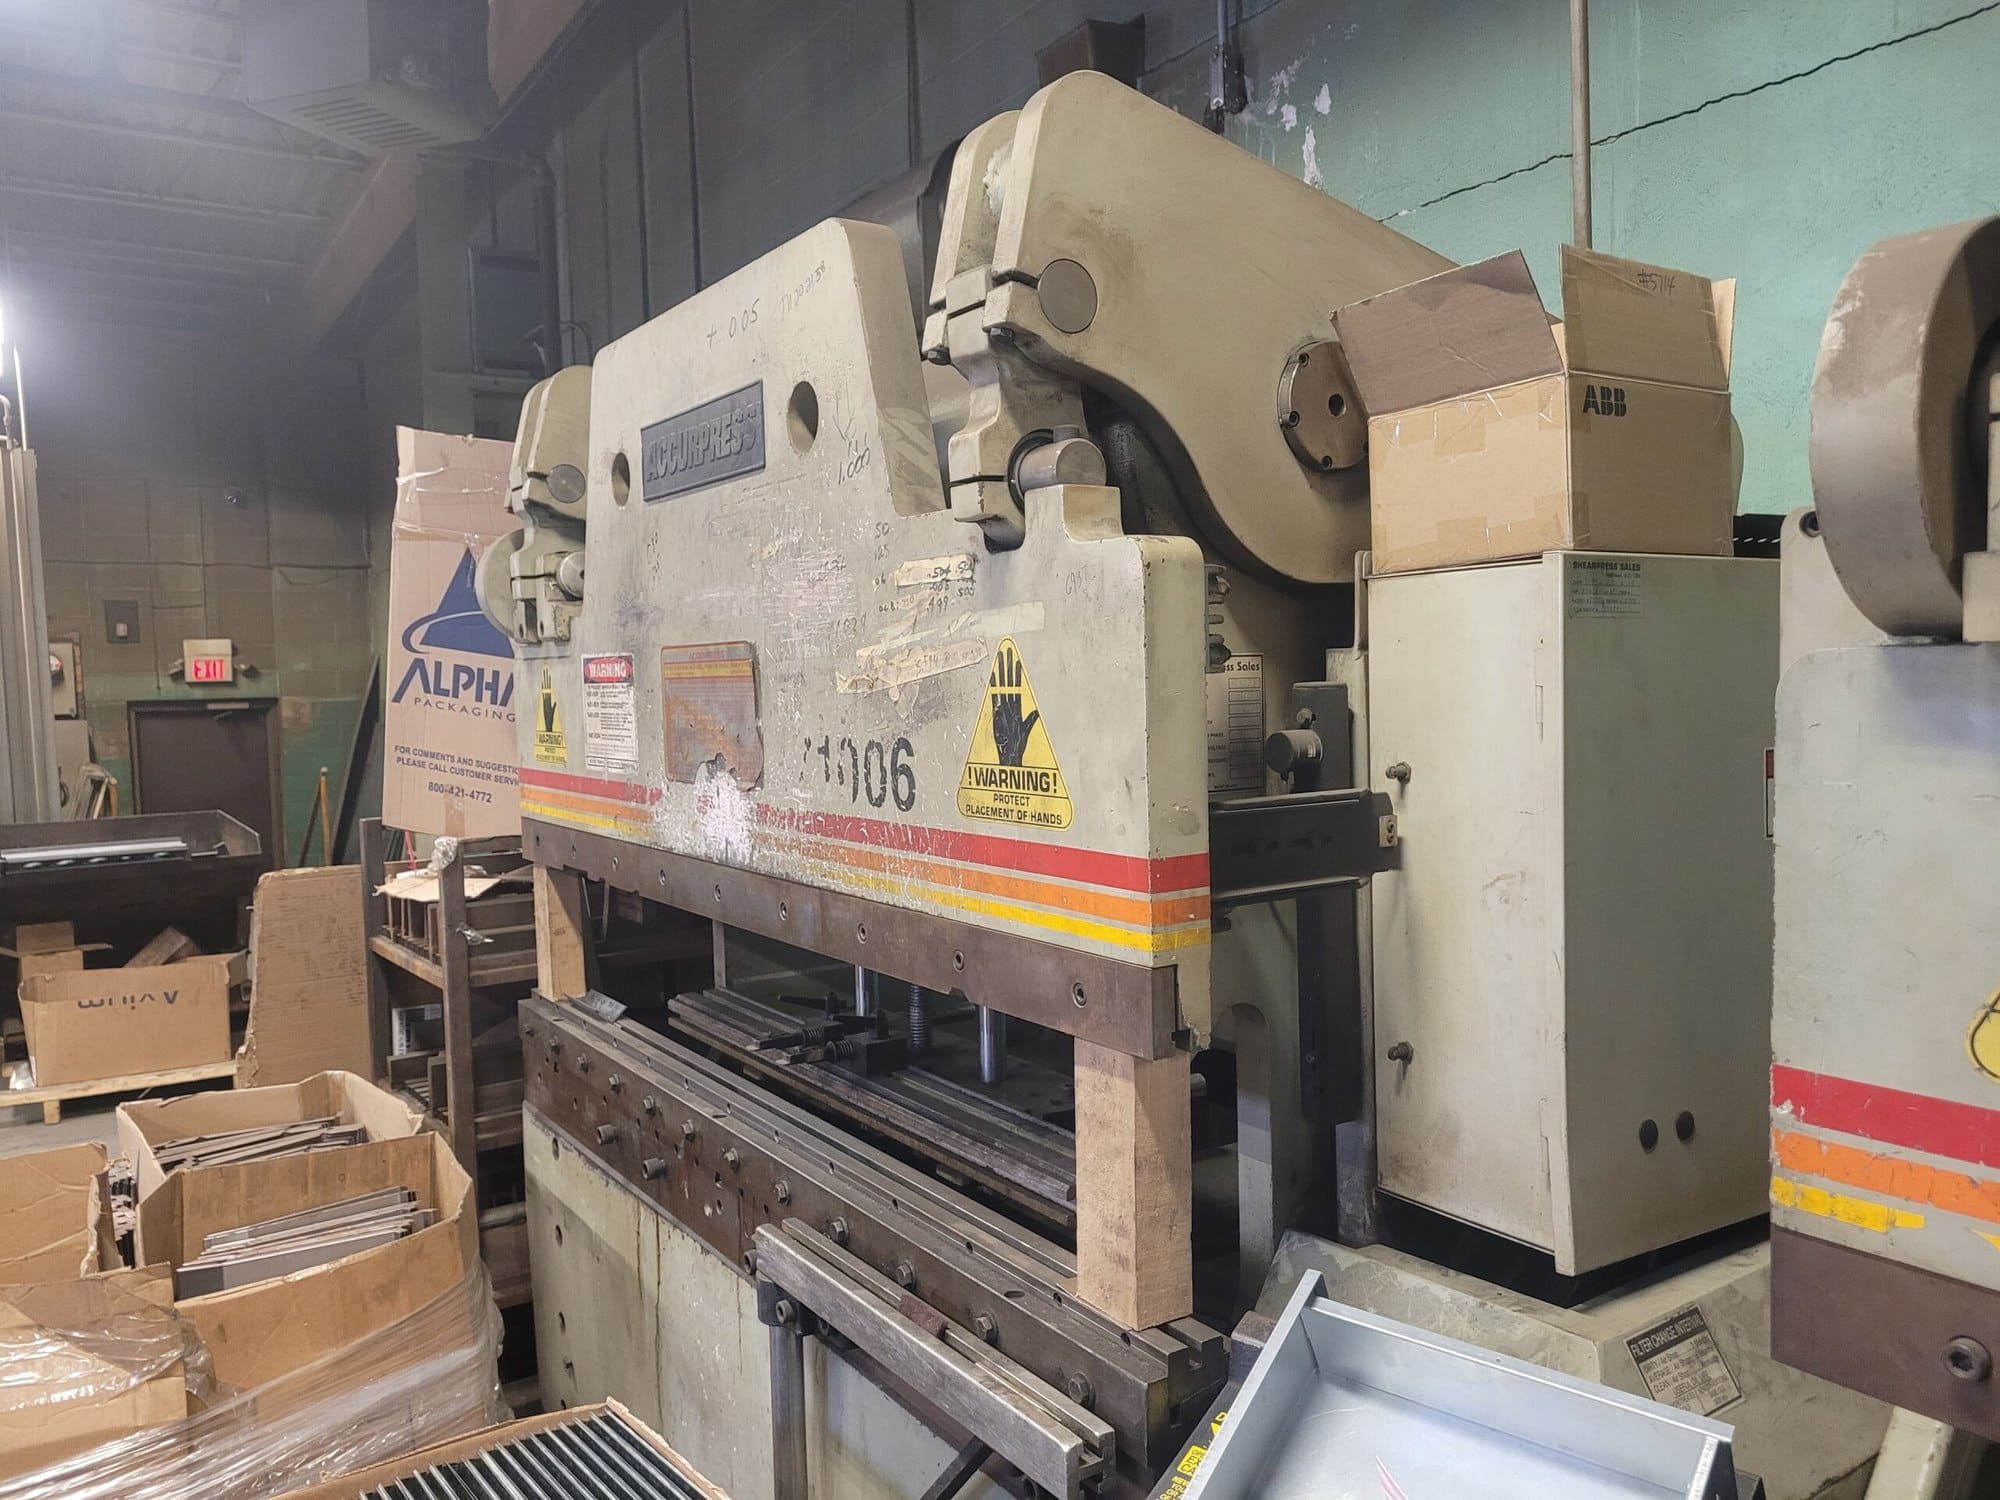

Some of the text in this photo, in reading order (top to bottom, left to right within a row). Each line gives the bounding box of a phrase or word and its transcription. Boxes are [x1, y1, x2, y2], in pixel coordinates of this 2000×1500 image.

[1582, 384, 1627, 417] ABB
[645, 402, 759, 482] ACCURPRESS
[193, 658, 225, 681] EXIT
[588, 662, 627, 678] WARNING
[1237, 661, 1260, 672] Sales
[413, 697, 516, 722] PACKAGING
[394, 744, 411, 755] FOR
[412, 748, 455, 763] COMMENTS
[456, 756, 473, 766] AND
[396, 756, 426, 769] PLEASE
[428, 762, 448, 773] CALL
[449, 766, 492, 781] CUSTOMER
[428, 782, 492, 803] 800-421-4772
[993, 792, 1031, 807] PROTECT
[965, 804, 1063, 825] PLACEMENT OF HANDS
